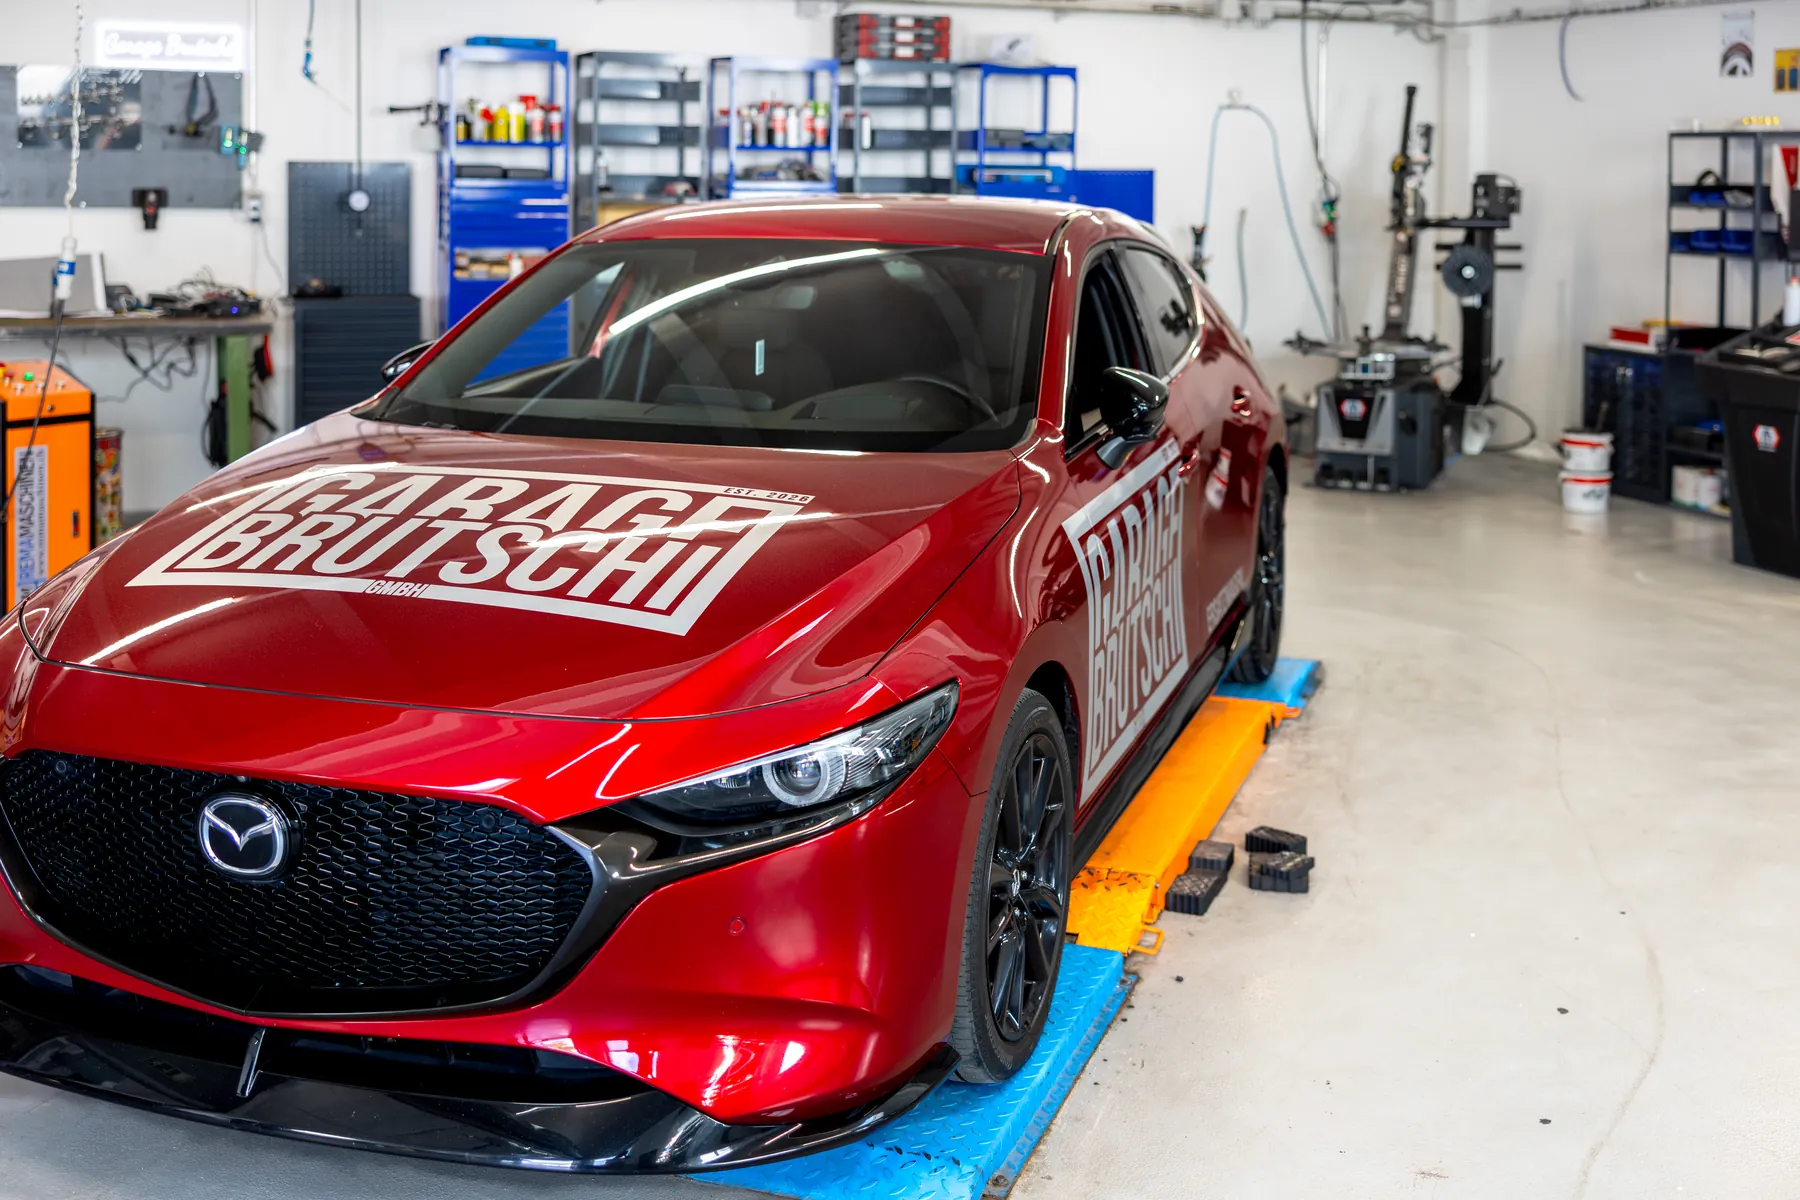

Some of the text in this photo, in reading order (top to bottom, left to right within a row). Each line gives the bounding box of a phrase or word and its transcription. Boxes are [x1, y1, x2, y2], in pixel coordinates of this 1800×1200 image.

[258, 472, 780, 541] GARAGE
[724, 487, 810, 502] EST. 2026
[174, 513, 722, 611] BRUTSCHI
[365, 580, 430, 598] GMBH
[1086, 460, 1184, 650] GARAGE
[1092, 560, 1184, 763] BRUTSCHI
